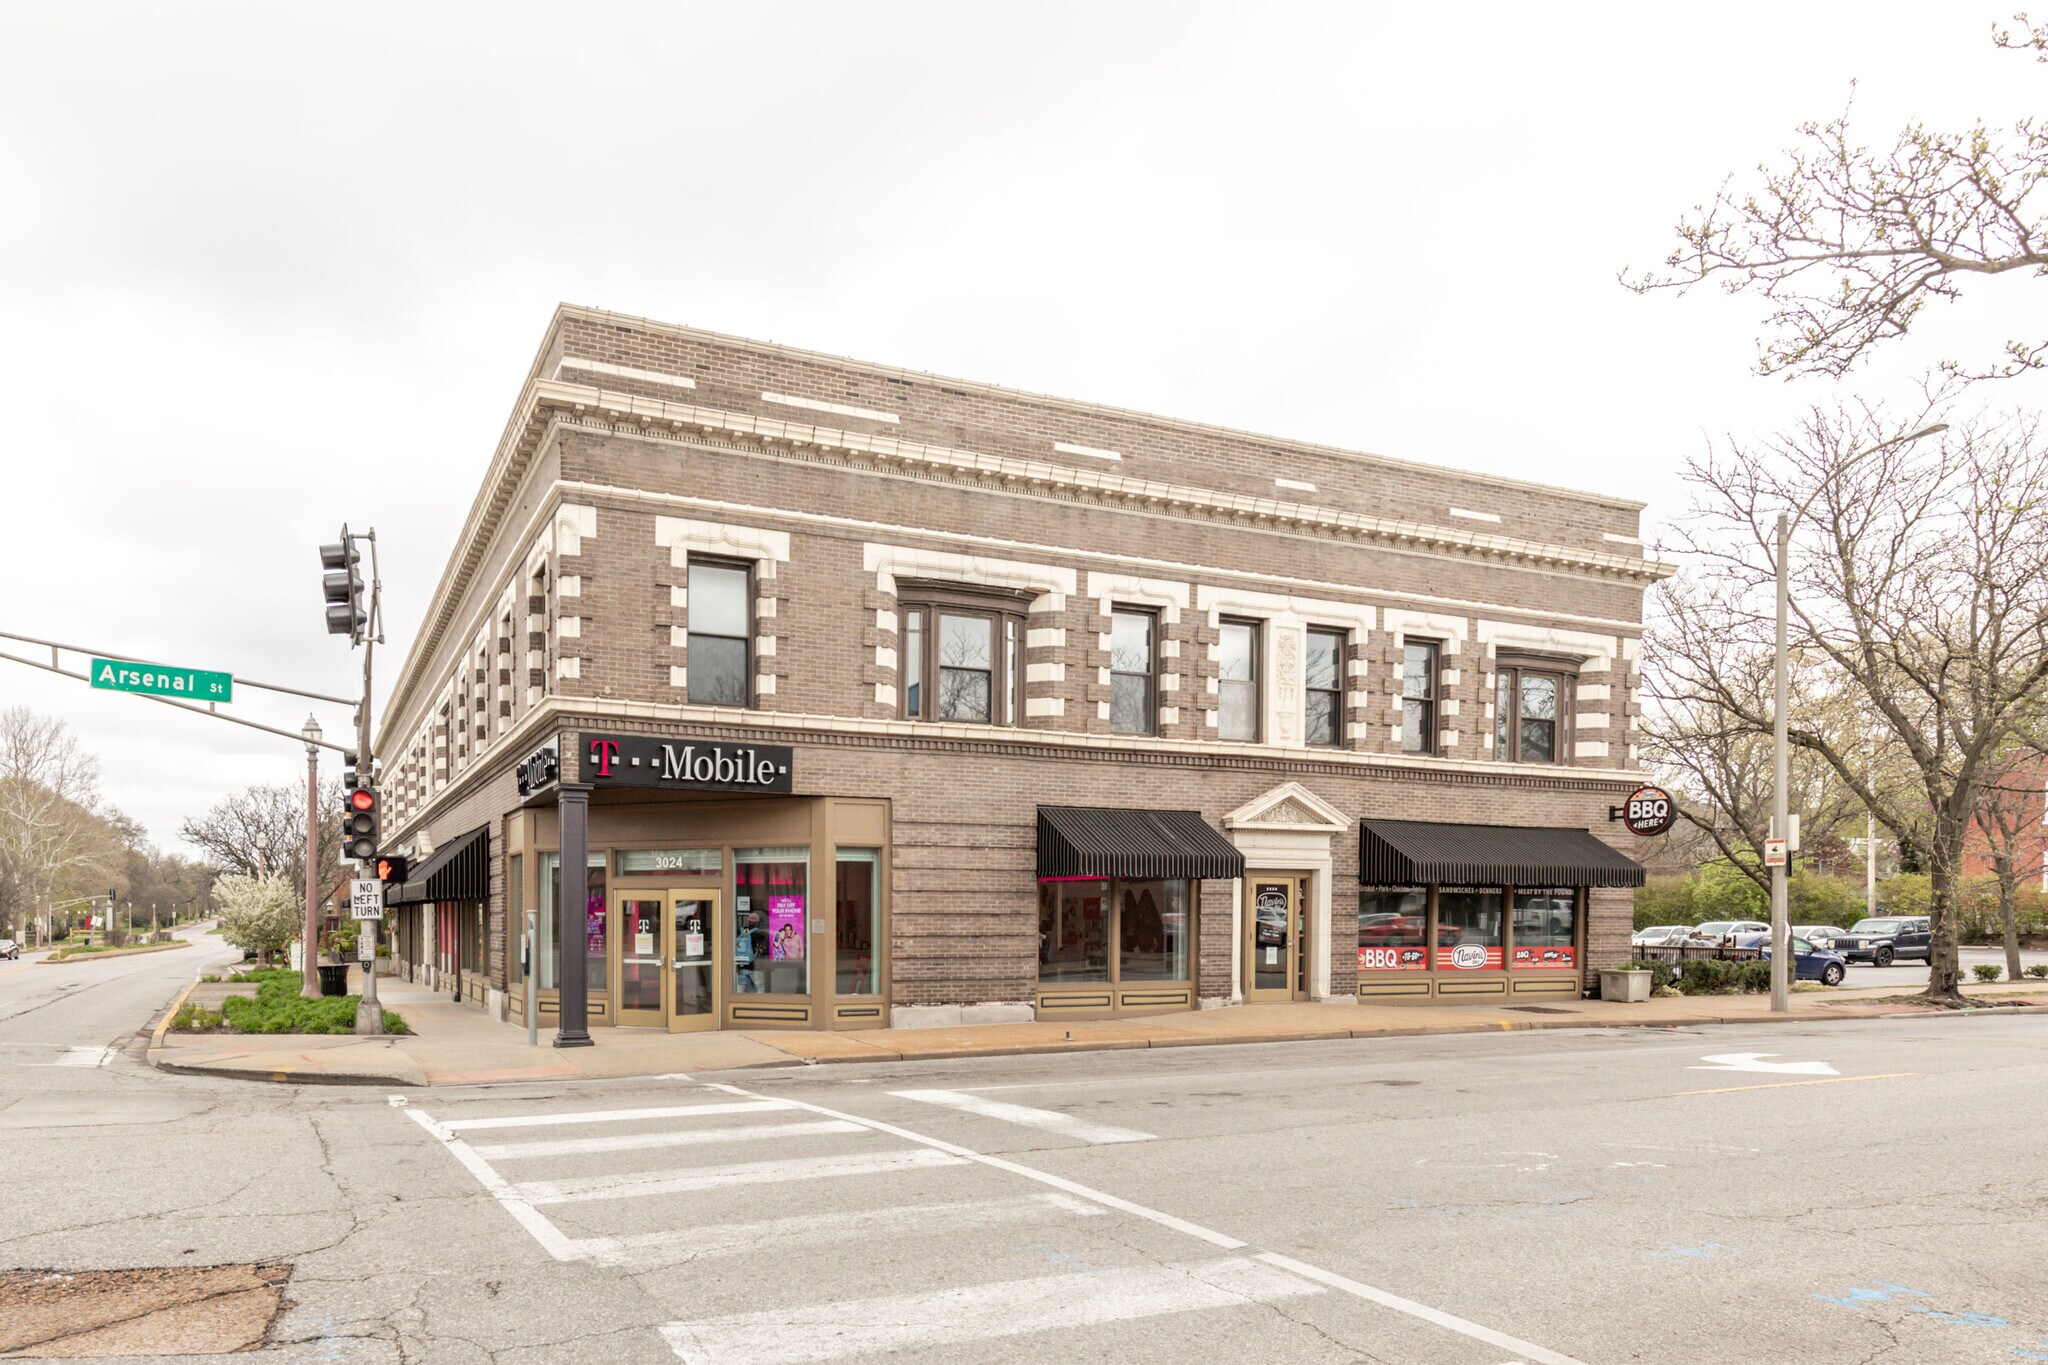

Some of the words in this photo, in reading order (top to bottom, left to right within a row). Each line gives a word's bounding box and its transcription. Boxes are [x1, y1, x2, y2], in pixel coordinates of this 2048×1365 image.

[98, 664, 194, 692] Arsenal
[209, 683, 223, 694] St
[1629, 800, 1669, 819] BBQ
[1637, 818, 1660, 829] HERE
[655, 856, 683, 869] 3024
[359, 883, 373, 893] NO
[1438, 886, 1475, 894] SANDWICHES
[1479, 887, 1502, 895] DINNERS
[353, 894, 379, 905] LEFT
[354, 906, 380, 917] TURN
[1365, 949, 1397, 969] BBQ
